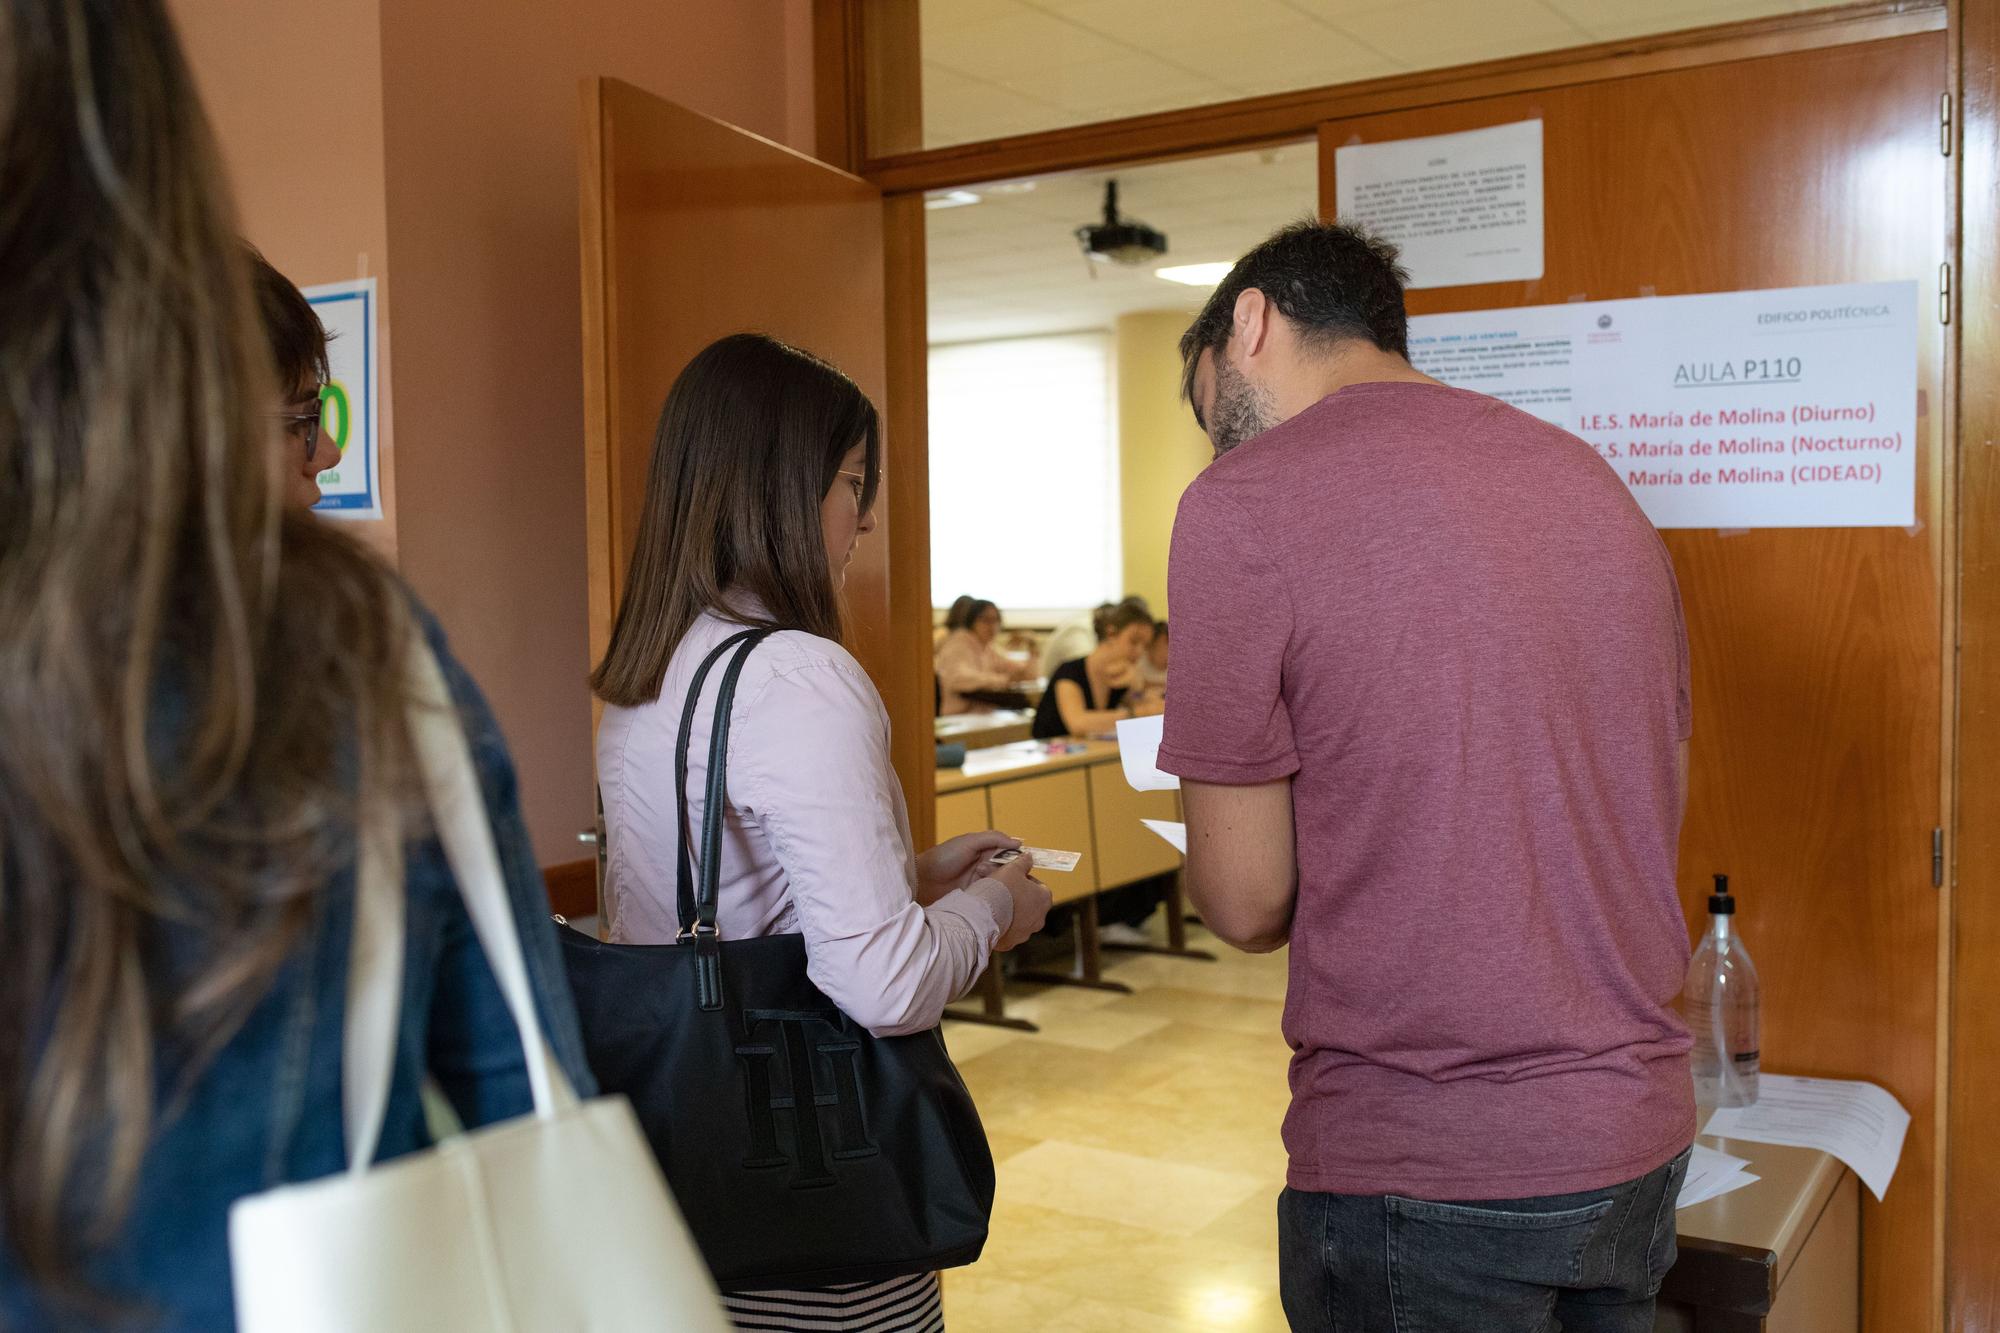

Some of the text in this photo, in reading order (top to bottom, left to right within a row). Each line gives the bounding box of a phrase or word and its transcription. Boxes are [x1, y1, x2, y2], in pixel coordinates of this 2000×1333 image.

[1757, 303, 1890, 325] EDIFICIO POLITÉCNICA
[1674, 356, 1802, 384] AULA P110
[1581, 402, 1875, 431] I.E.S. María de Molina (Diurno)
[1629, 439, 1683, 458] María
[1689, 439, 1713, 456] de
[1718, 436, 1785, 456] Molina
[1792, 432, 1902, 455] (Nocturno)
[1629, 463, 1882, 486] María de Molina (CIDEAD)
